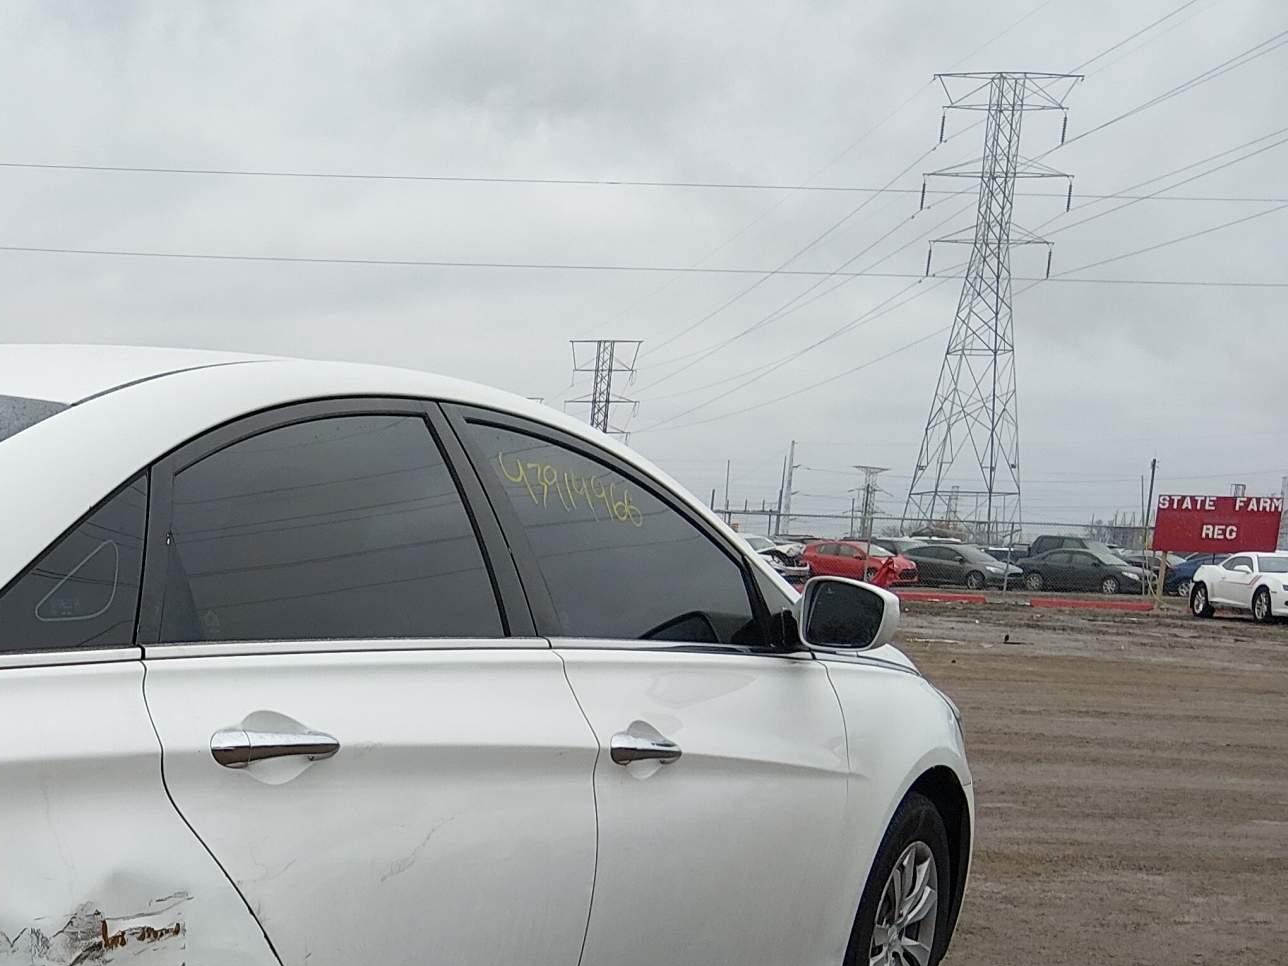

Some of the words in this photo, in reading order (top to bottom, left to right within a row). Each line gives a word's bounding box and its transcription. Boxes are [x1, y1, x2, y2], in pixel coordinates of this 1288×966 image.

[1158, 495, 1217, 511] STATE
[1235, 497, 1283, 513] FARM
[1201, 524, 1238, 540] REG
